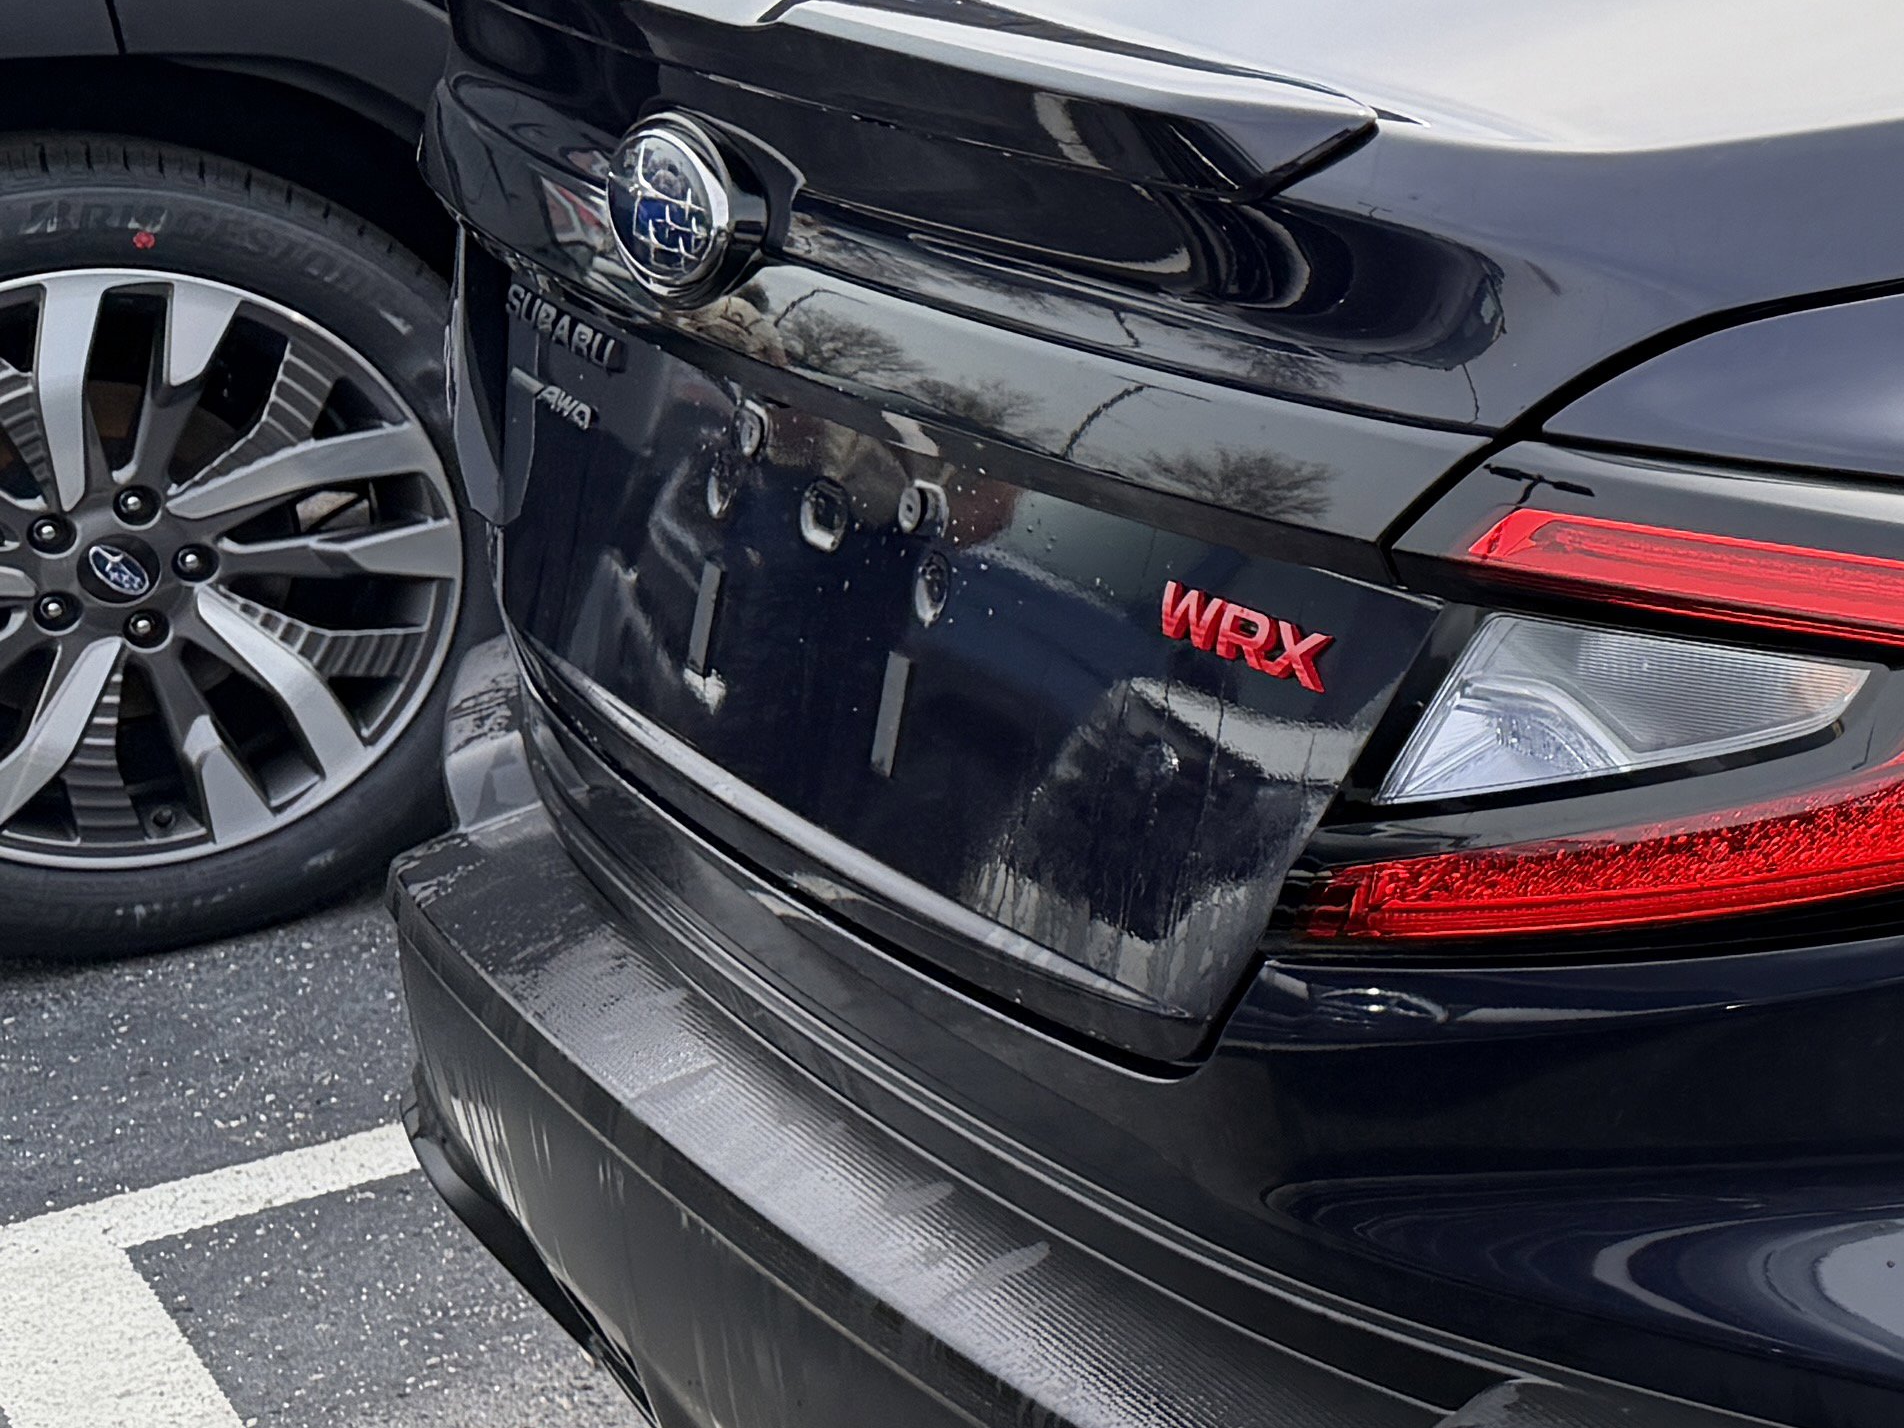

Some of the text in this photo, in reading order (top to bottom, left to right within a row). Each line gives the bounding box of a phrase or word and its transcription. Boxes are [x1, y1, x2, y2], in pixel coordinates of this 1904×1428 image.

[506, 283, 615, 367] SUBARU
[534, 385, 592, 430] AWD
[1162, 580, 1334, 694] WRX
